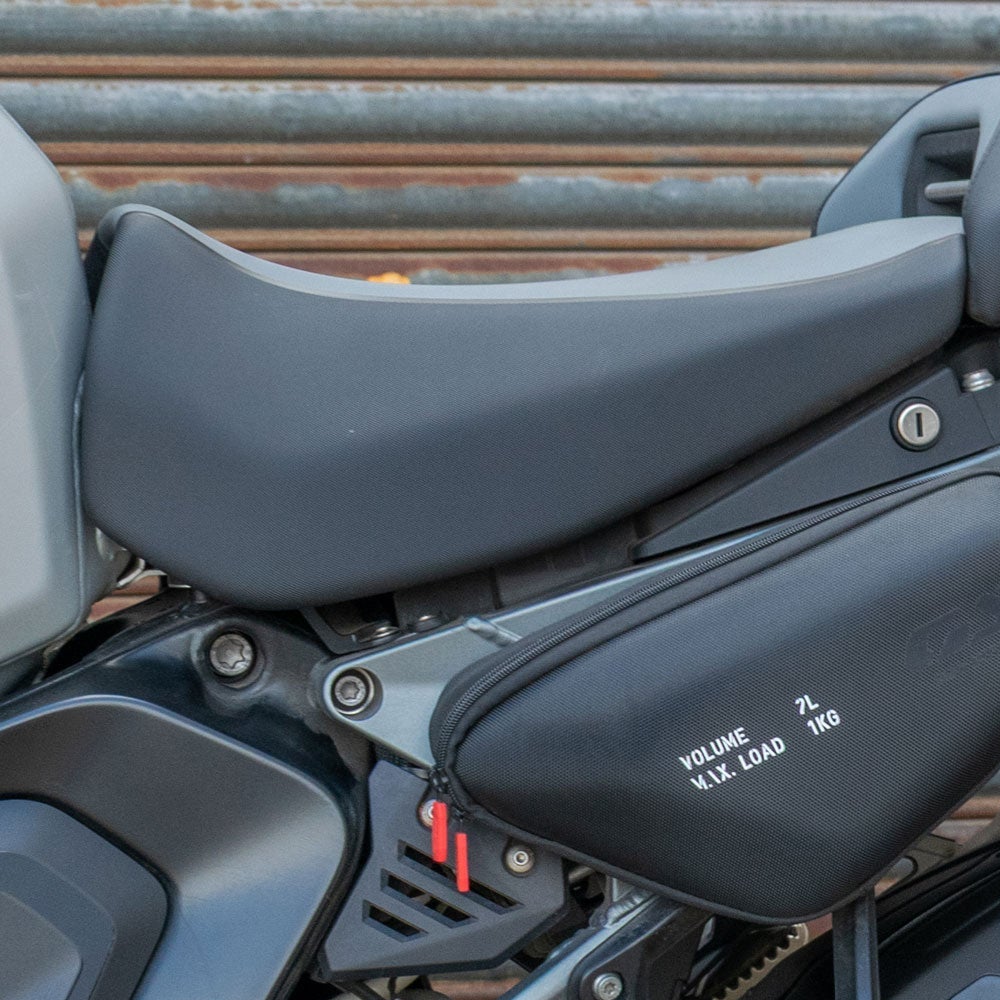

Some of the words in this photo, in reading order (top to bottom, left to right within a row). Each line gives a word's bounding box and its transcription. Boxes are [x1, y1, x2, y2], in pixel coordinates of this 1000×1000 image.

[679, 727, 750, 770] VOLUME
[795, 695, 819, 714] 2L
[738, 737, 786, 770] LOAD
[807, 709, 841, 735] 1KG
